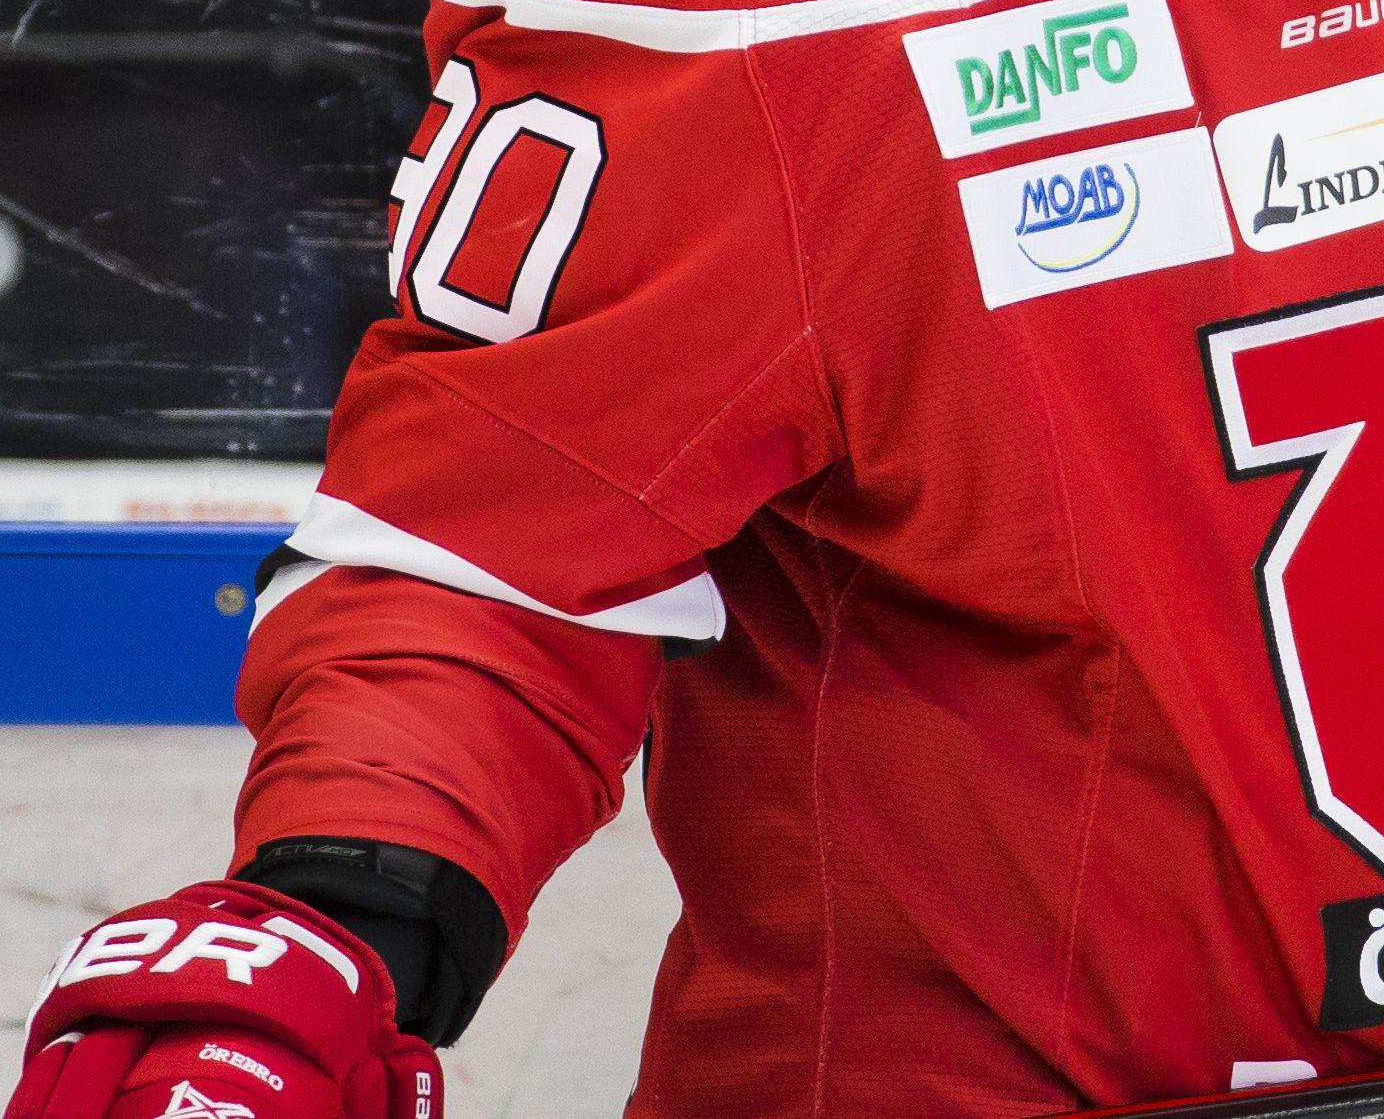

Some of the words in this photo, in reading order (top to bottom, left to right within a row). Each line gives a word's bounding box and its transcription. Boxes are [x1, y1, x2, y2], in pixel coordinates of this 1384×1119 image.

[954, 2, 1138, 137] DANFO
[1015, 162, 1126, 237] MOAB
[198, 1042, 284, 1091] ÖREBRO
